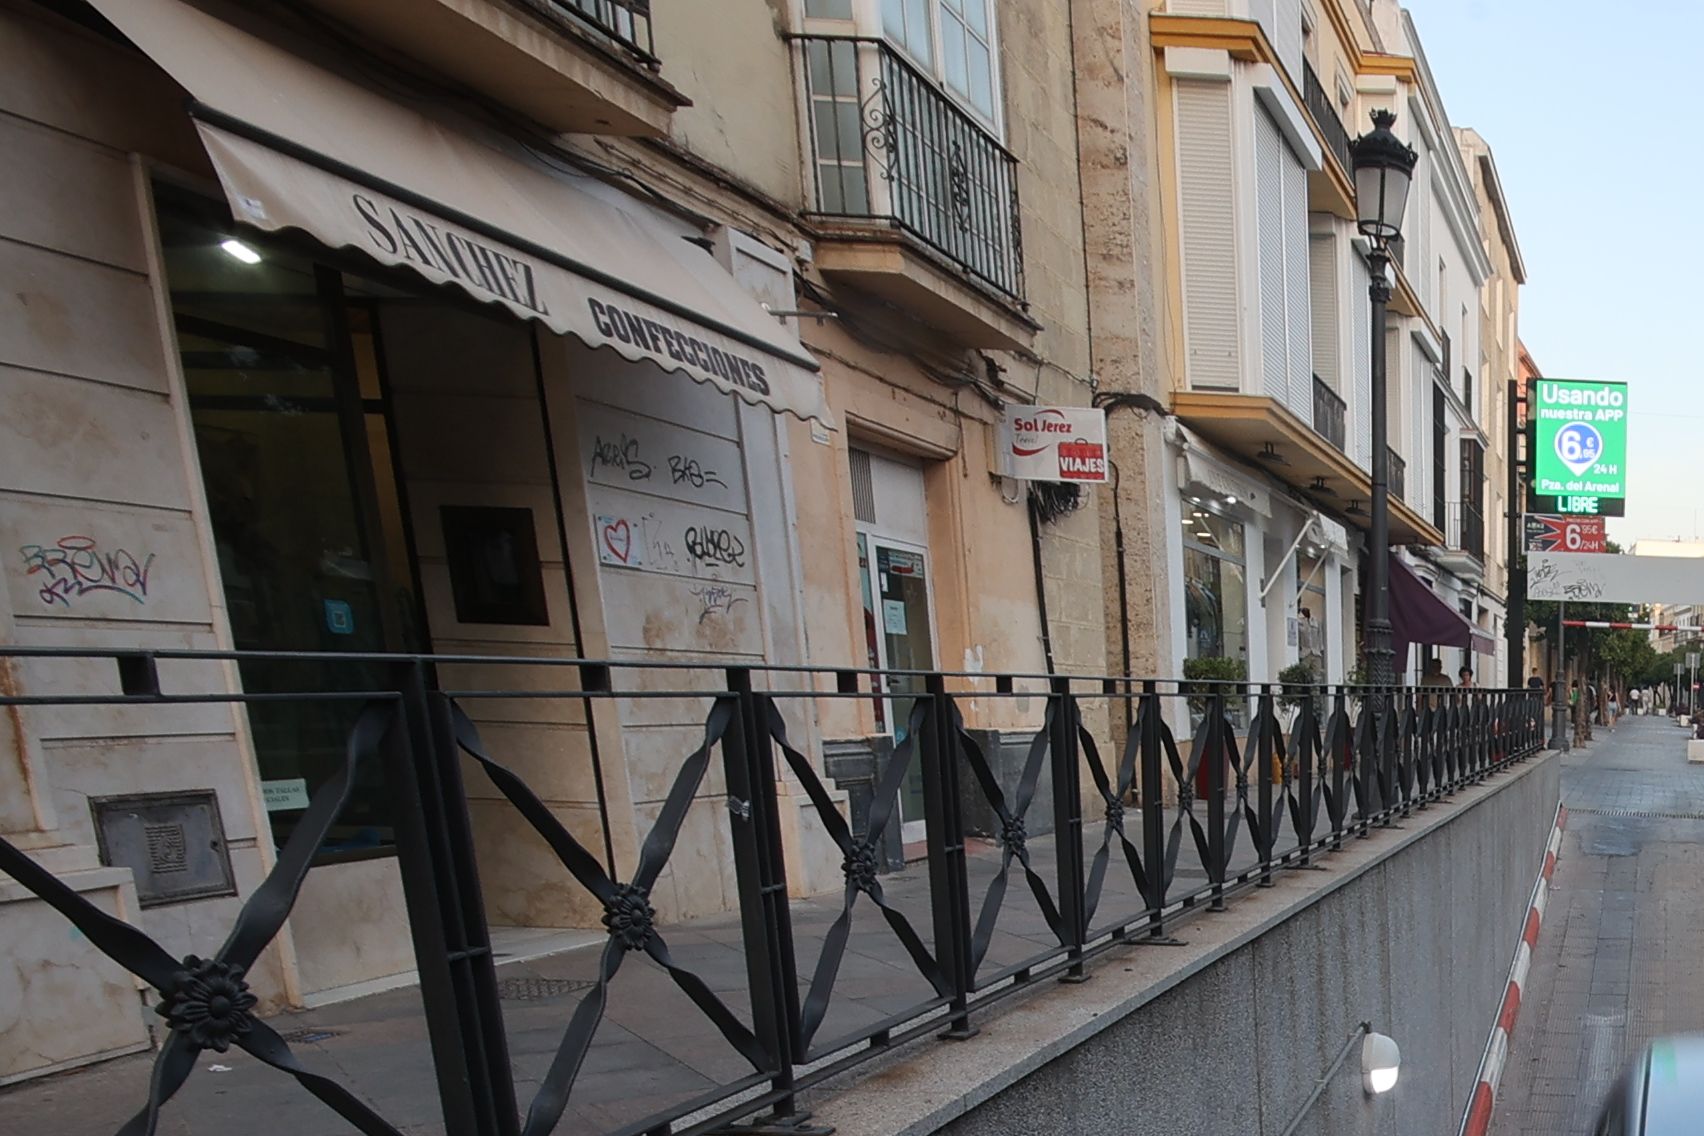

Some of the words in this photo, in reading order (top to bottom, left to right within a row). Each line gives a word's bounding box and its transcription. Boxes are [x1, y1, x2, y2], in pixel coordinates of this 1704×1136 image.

[352, 193, 549, 317] SANCHEZ
[587, 297, 771, 396] CONFECCIONES
[1542, 384, 1624, 406] Usando
[1541, 408, 1593, 421] nuestra
[1595, 408, 1624, 421] APP
[1014, 418, 1039, 432] Sol
[1041, 420, 1072, 433] Jerez
[1060, 457, 1105, 473] VIAJES
[1593, 464, 1607, 475] 24
[1609, 464, 1617, 475] H
[1541, 479, 1564, 490] Pza.
[1566, 480, 1582, 491] del
[1584, 481, 1619, 493] Arenal
[1558, 496, 1599, 513] LIBRE
[1565, 524, 1581, 550] 6
